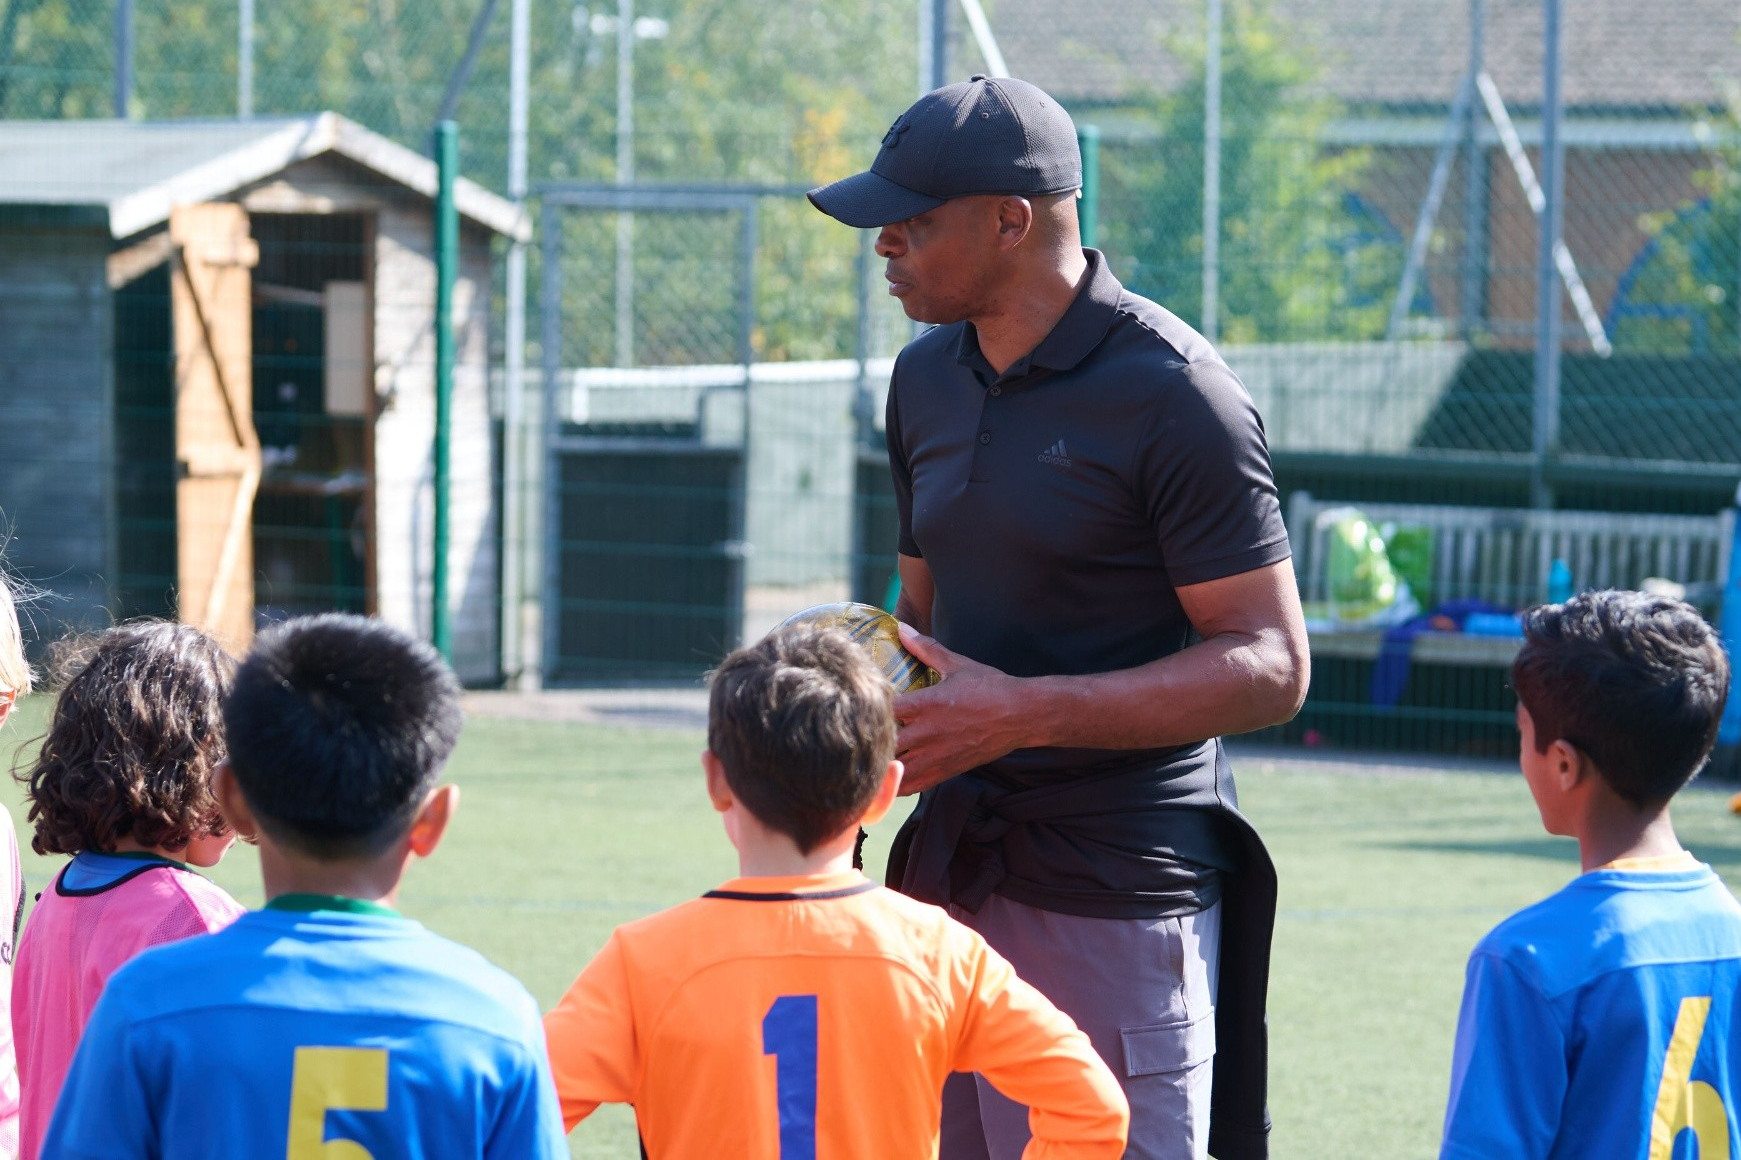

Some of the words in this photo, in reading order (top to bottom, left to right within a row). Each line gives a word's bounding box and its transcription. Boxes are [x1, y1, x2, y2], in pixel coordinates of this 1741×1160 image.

[1037, 453, 1072, 467] adidas
[762, 995, 818, 1160] 1
[1649, 996, 1731, 1160] 6
